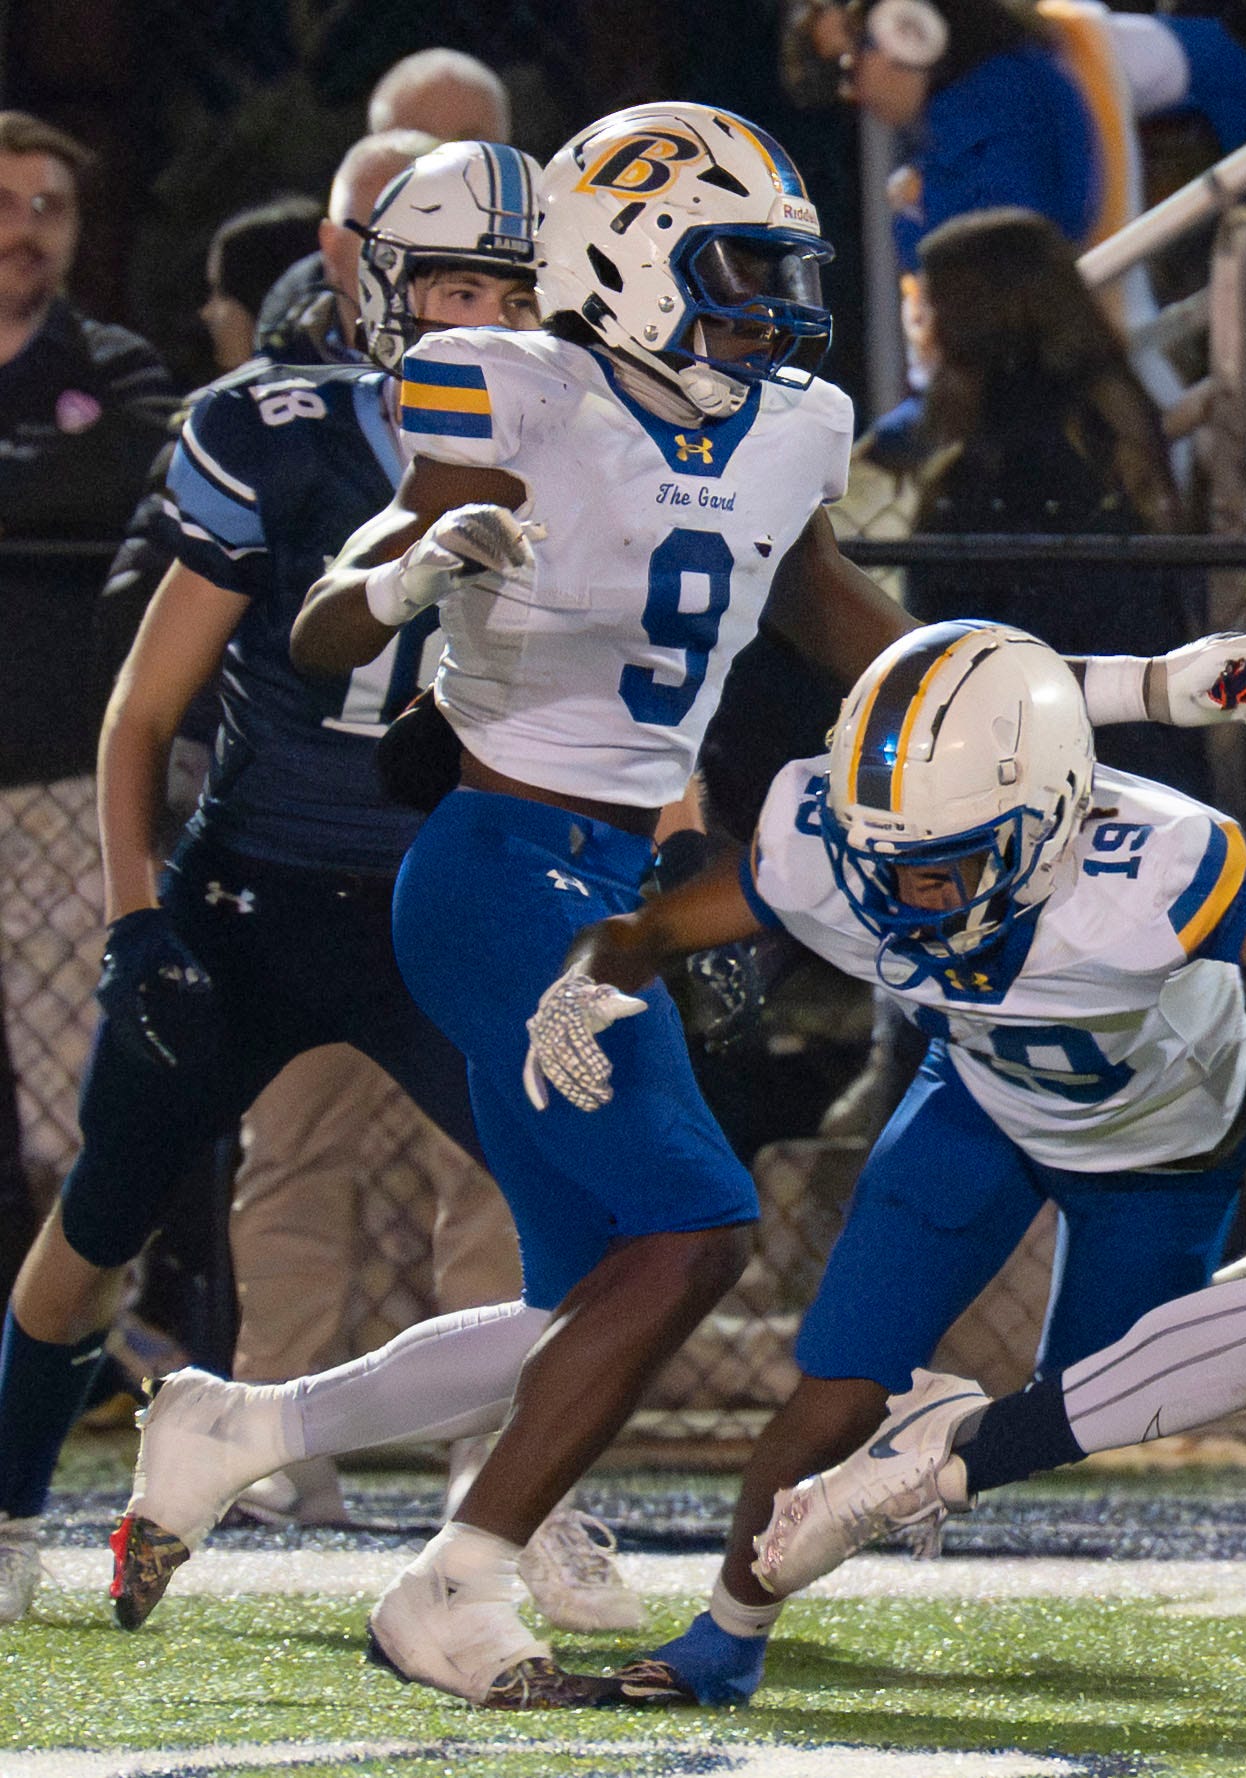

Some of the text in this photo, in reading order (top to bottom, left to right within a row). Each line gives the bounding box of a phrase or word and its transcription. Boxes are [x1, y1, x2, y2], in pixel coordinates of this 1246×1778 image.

[248, 377, 327, 427] 18
[655, 483, 737, 512] The Gard
[618, 527, 735, 727] 9
[1082, 823, 1154, 880] 19
